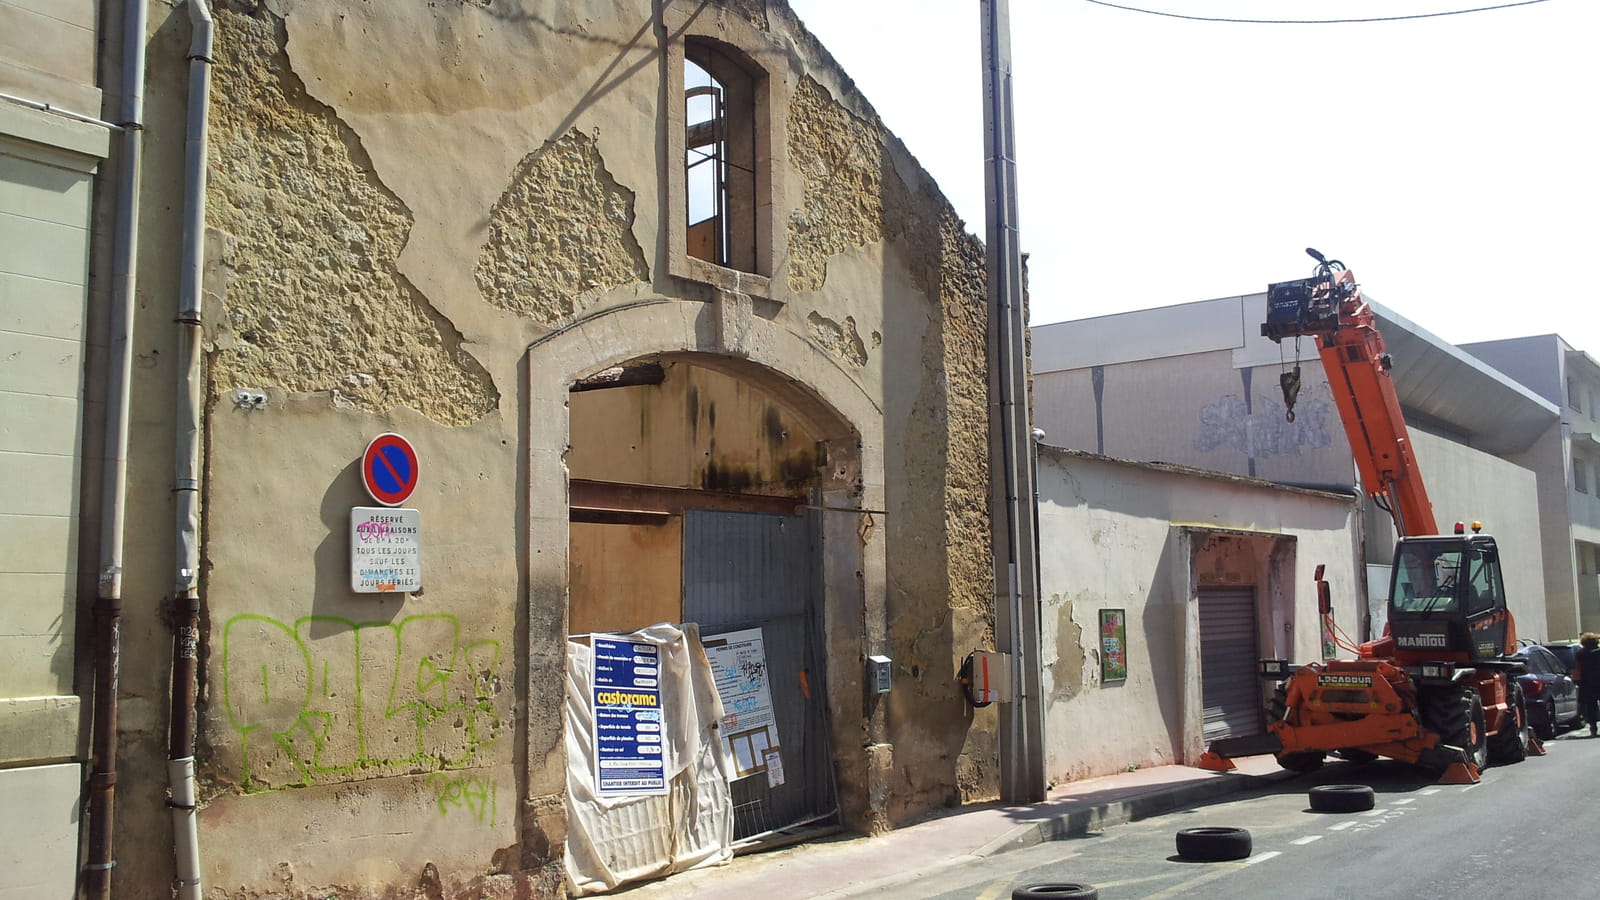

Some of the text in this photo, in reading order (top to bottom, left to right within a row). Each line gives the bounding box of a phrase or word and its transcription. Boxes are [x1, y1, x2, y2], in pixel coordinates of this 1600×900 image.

[356, 547, 417, 555] TOUS LES JOURS
[359, 568, 415, 576] DIMANCHES ET
[360, 579, 385, 587] JOURS
[597, 690, 657, 706] castorama
